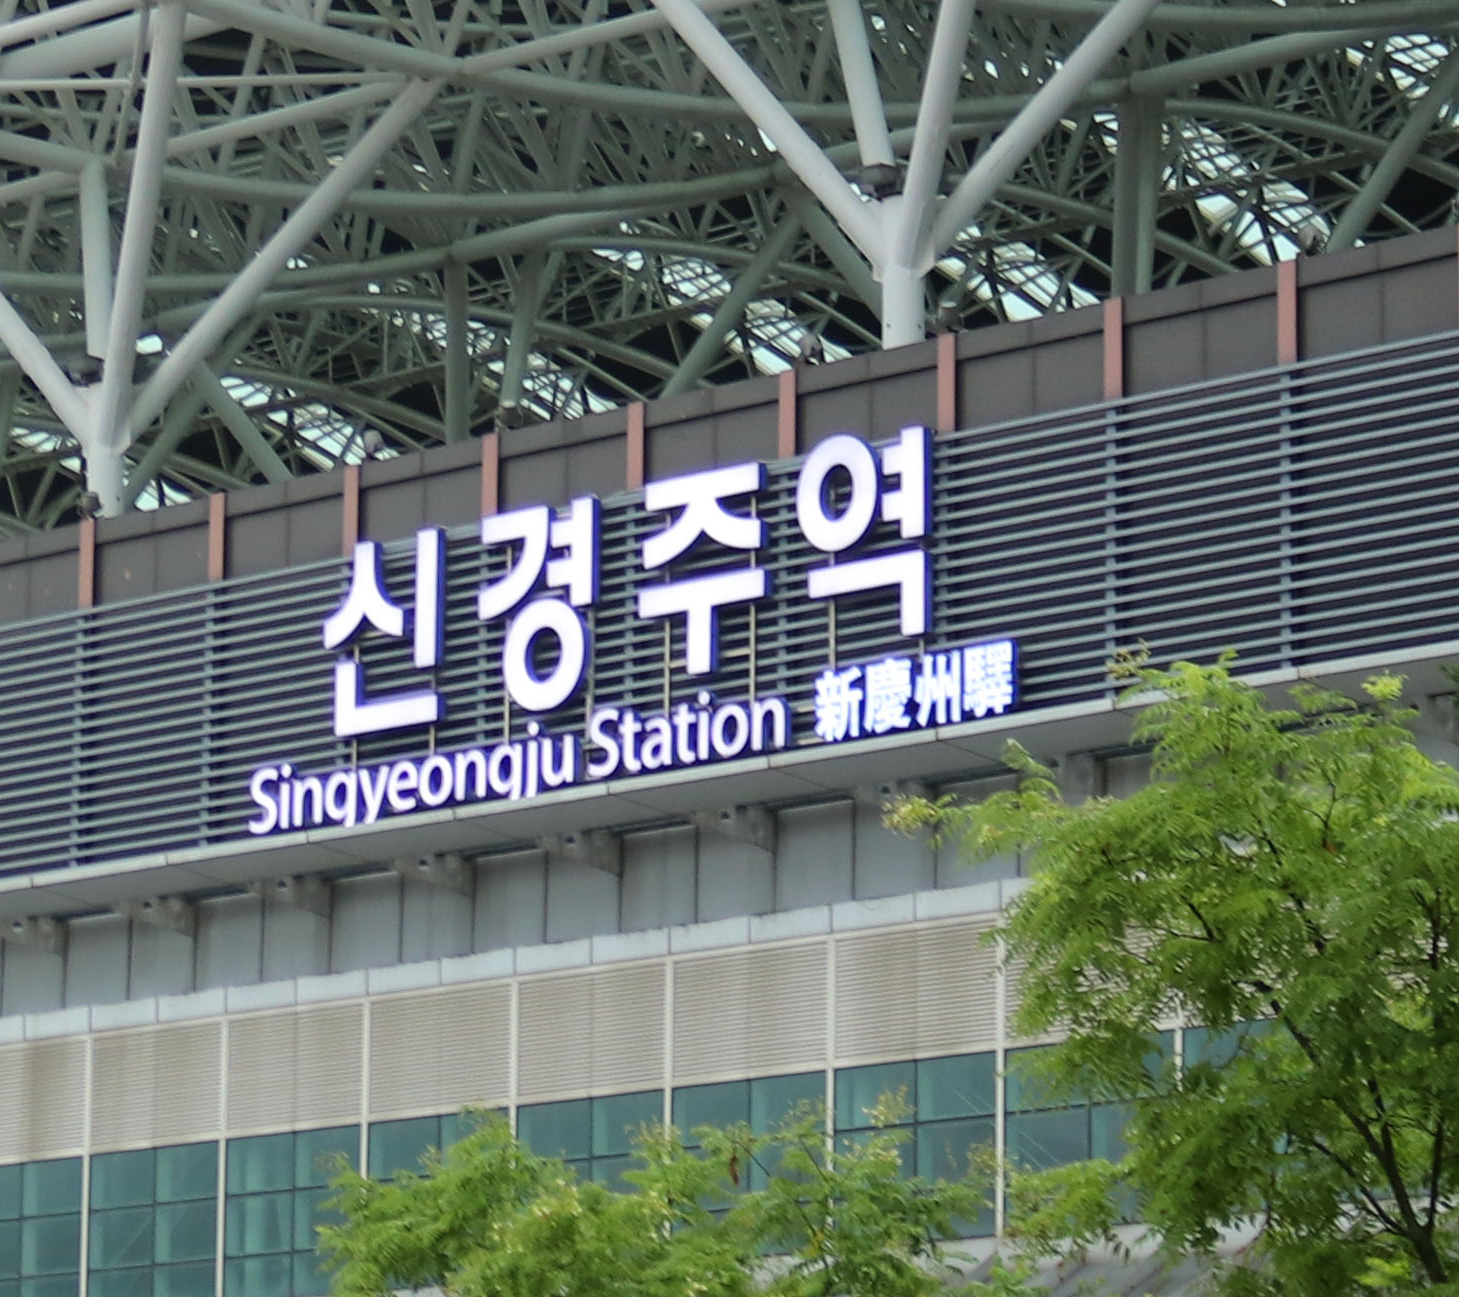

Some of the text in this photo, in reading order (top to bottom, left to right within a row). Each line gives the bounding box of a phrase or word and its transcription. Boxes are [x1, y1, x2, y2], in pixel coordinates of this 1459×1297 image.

[323, 424, 933, 737] 신경주역
[814, 639, 1016, 742] 新慶州驛
[247, 691, 787, 835] Singyeongju Station
